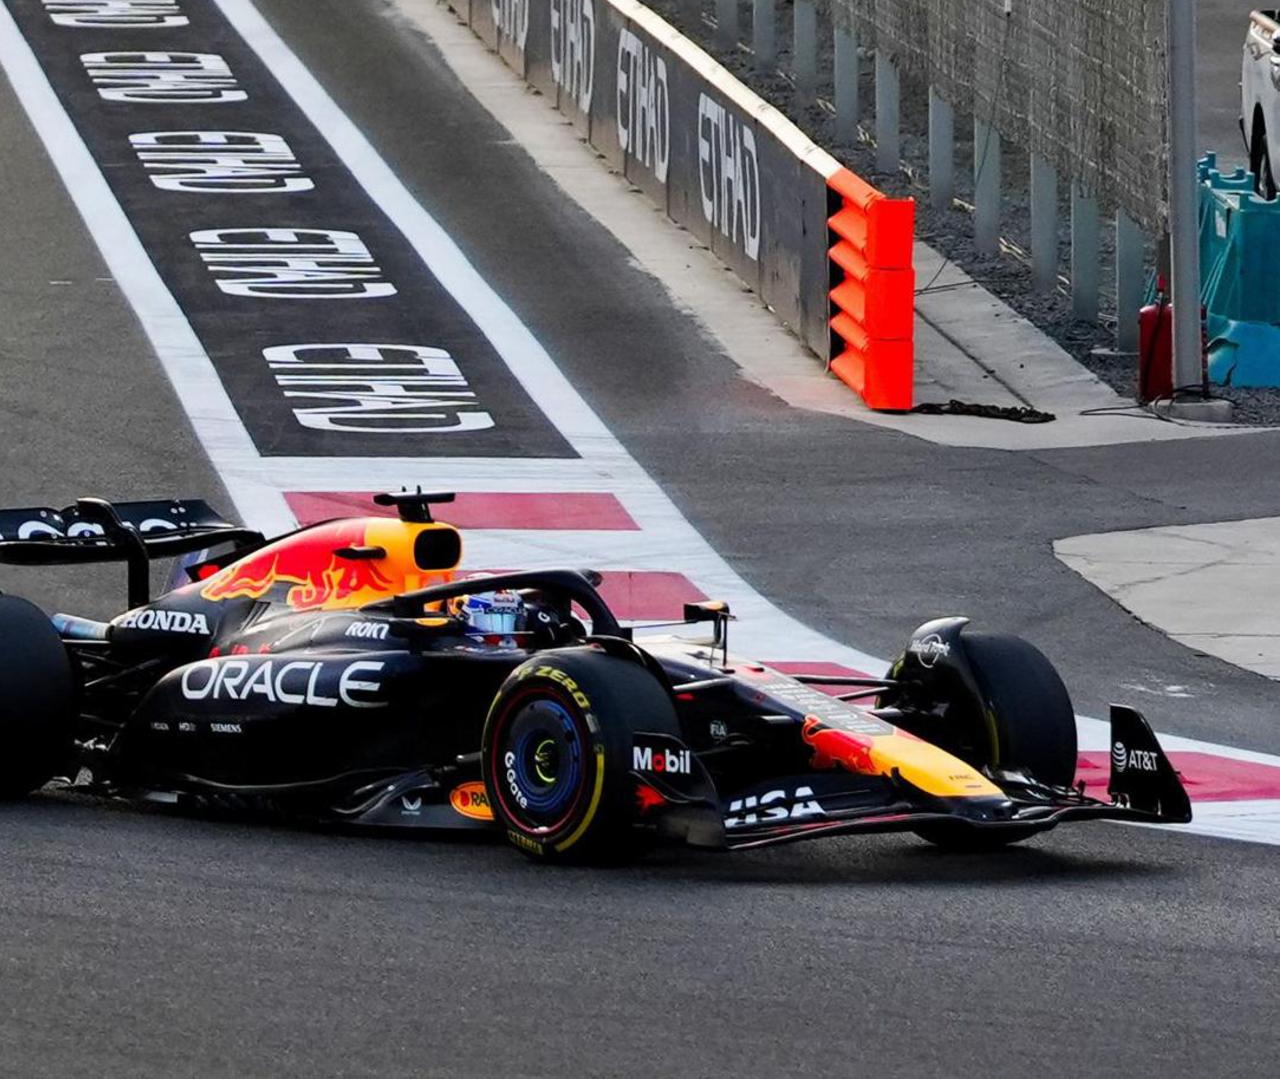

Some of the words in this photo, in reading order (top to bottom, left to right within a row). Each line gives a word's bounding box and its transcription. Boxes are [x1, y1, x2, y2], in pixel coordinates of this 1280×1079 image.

[80, 51, 247, 103] ETIHAD
[616, 27, 670, 184] ETIHAD
[128, 131, 315, 194] ETIHAD
[698, 92, 760, 261] ETIHAD
[189, 227, 397, 299] ETIHAD
[262, 343, 495, 432] ETIHAD
[120, 610, 211, 636] HONDA
[181, 660, 390, 708] ORACLE
[535, 665, 590, 709] ZERO
[210, 722, 242, 734] SIEMENS
[633, 746, 691, 775] Mobil
[1128, 750, 1158, 771] AT&T
